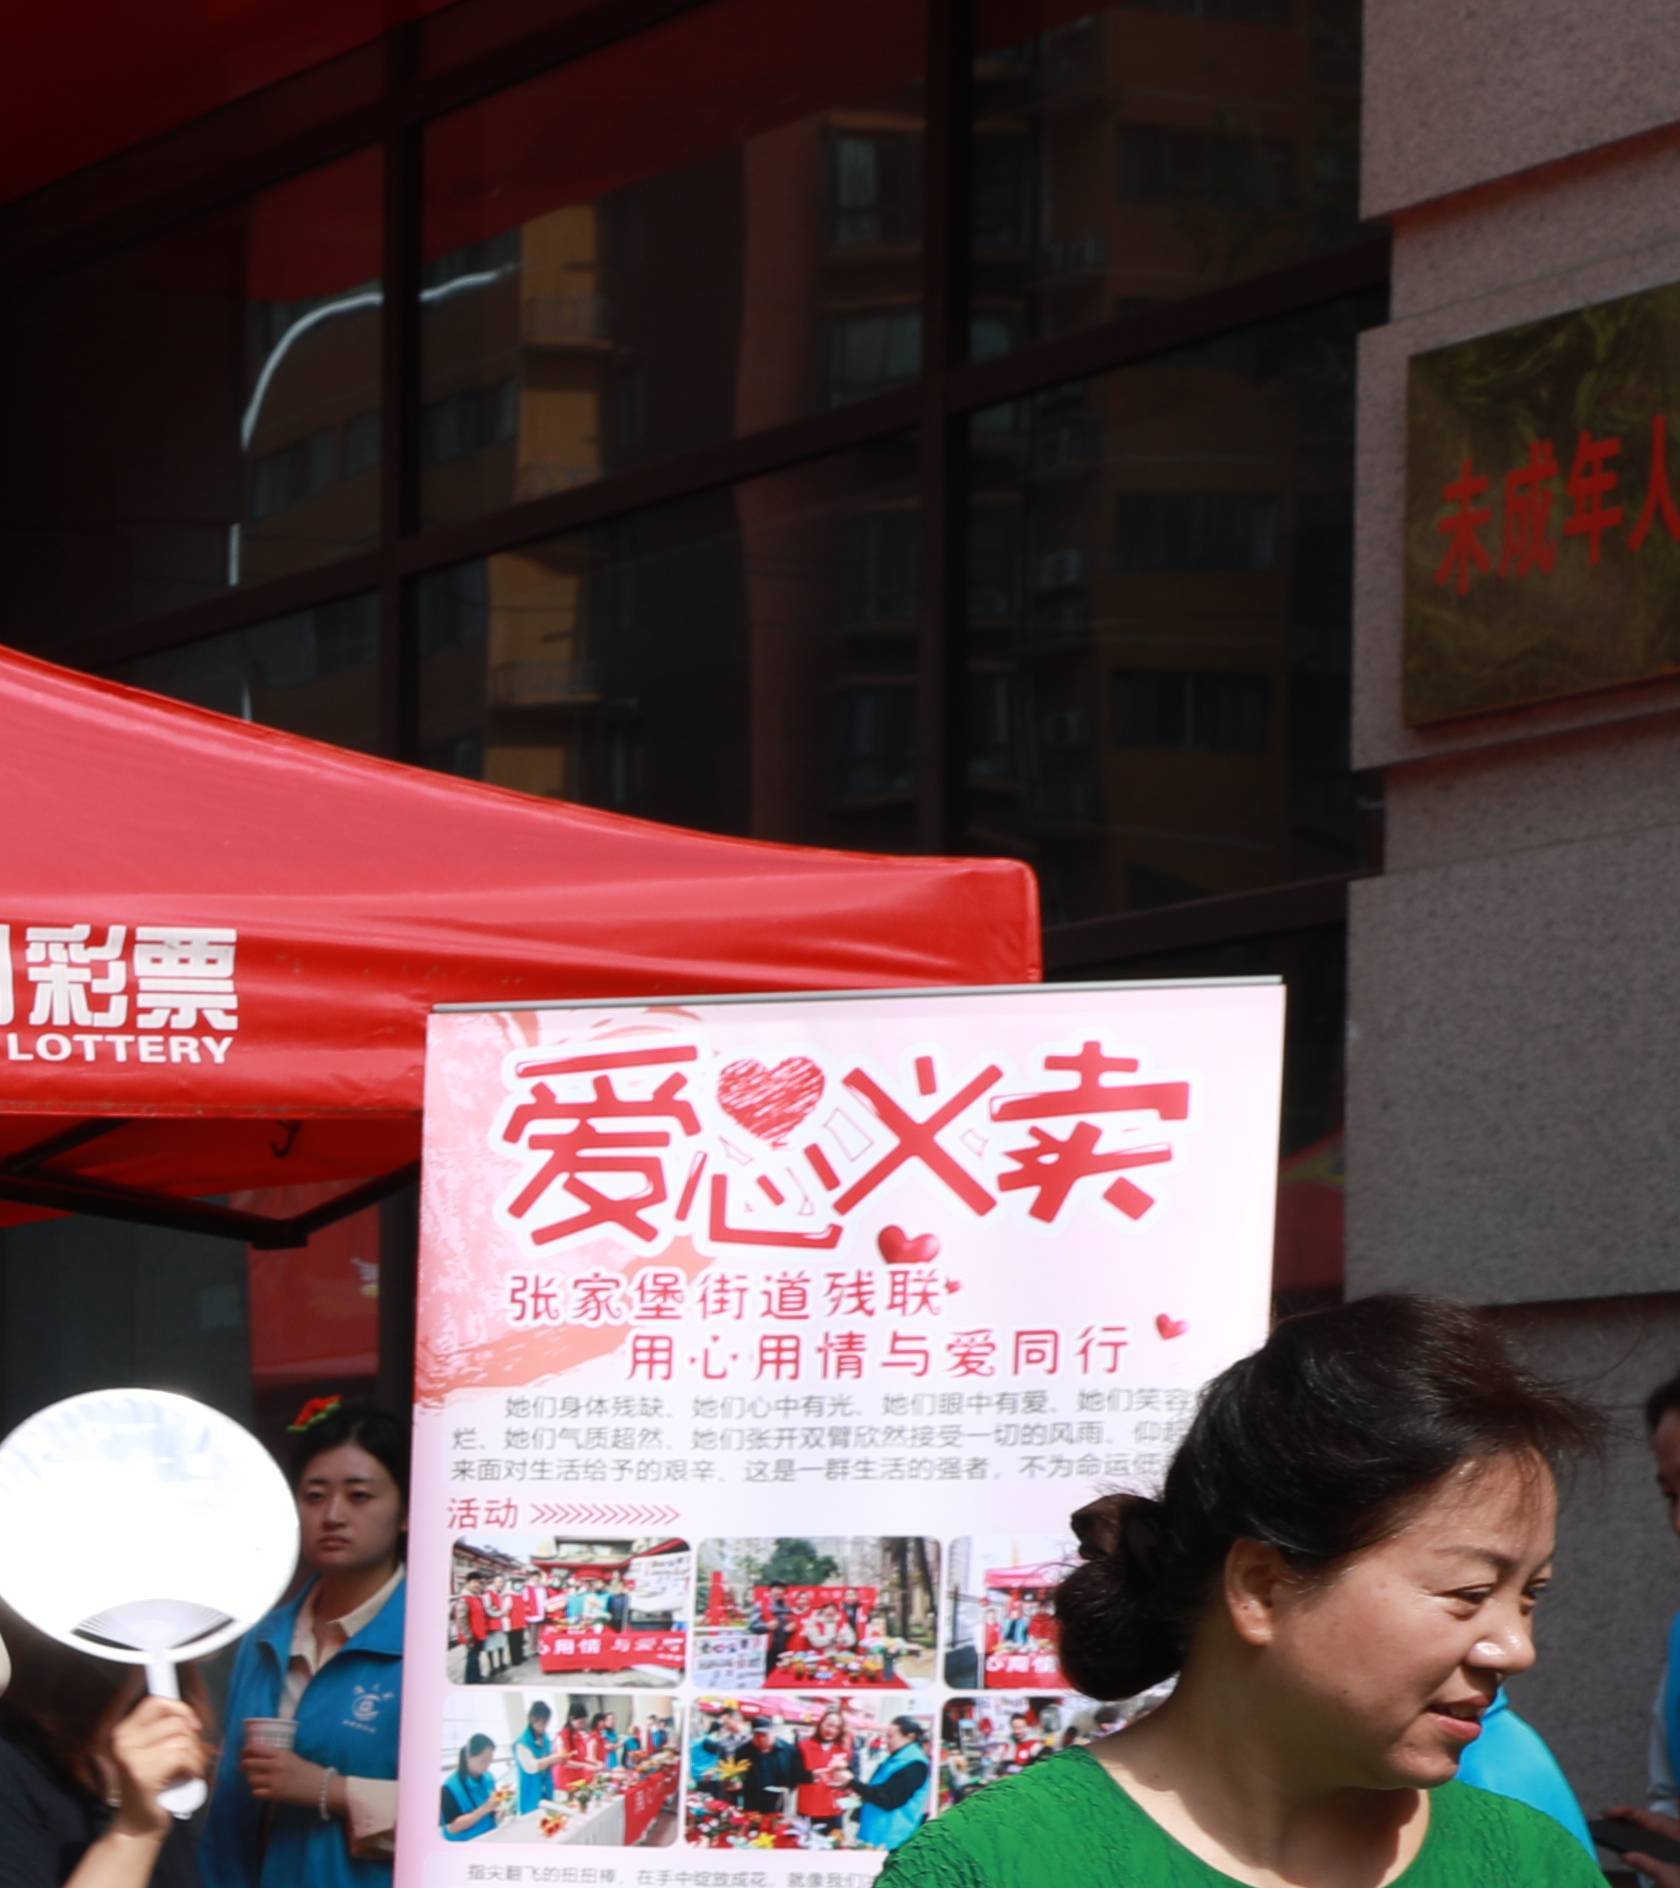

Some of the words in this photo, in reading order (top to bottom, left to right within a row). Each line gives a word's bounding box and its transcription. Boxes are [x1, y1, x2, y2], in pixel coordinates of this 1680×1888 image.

[1433, 412, 1680, 598] 未成年人
[7, 1032, 234, 1064] LOTTERY
[503, 1041, 1190, 1250] 爱心义卖
[509, 1268, 945, 1322] 张家堡街道残联
[625, 1325, 1130, 1382] 用心用情与爱同行
[447, 1498, 517, 1529] 活动
